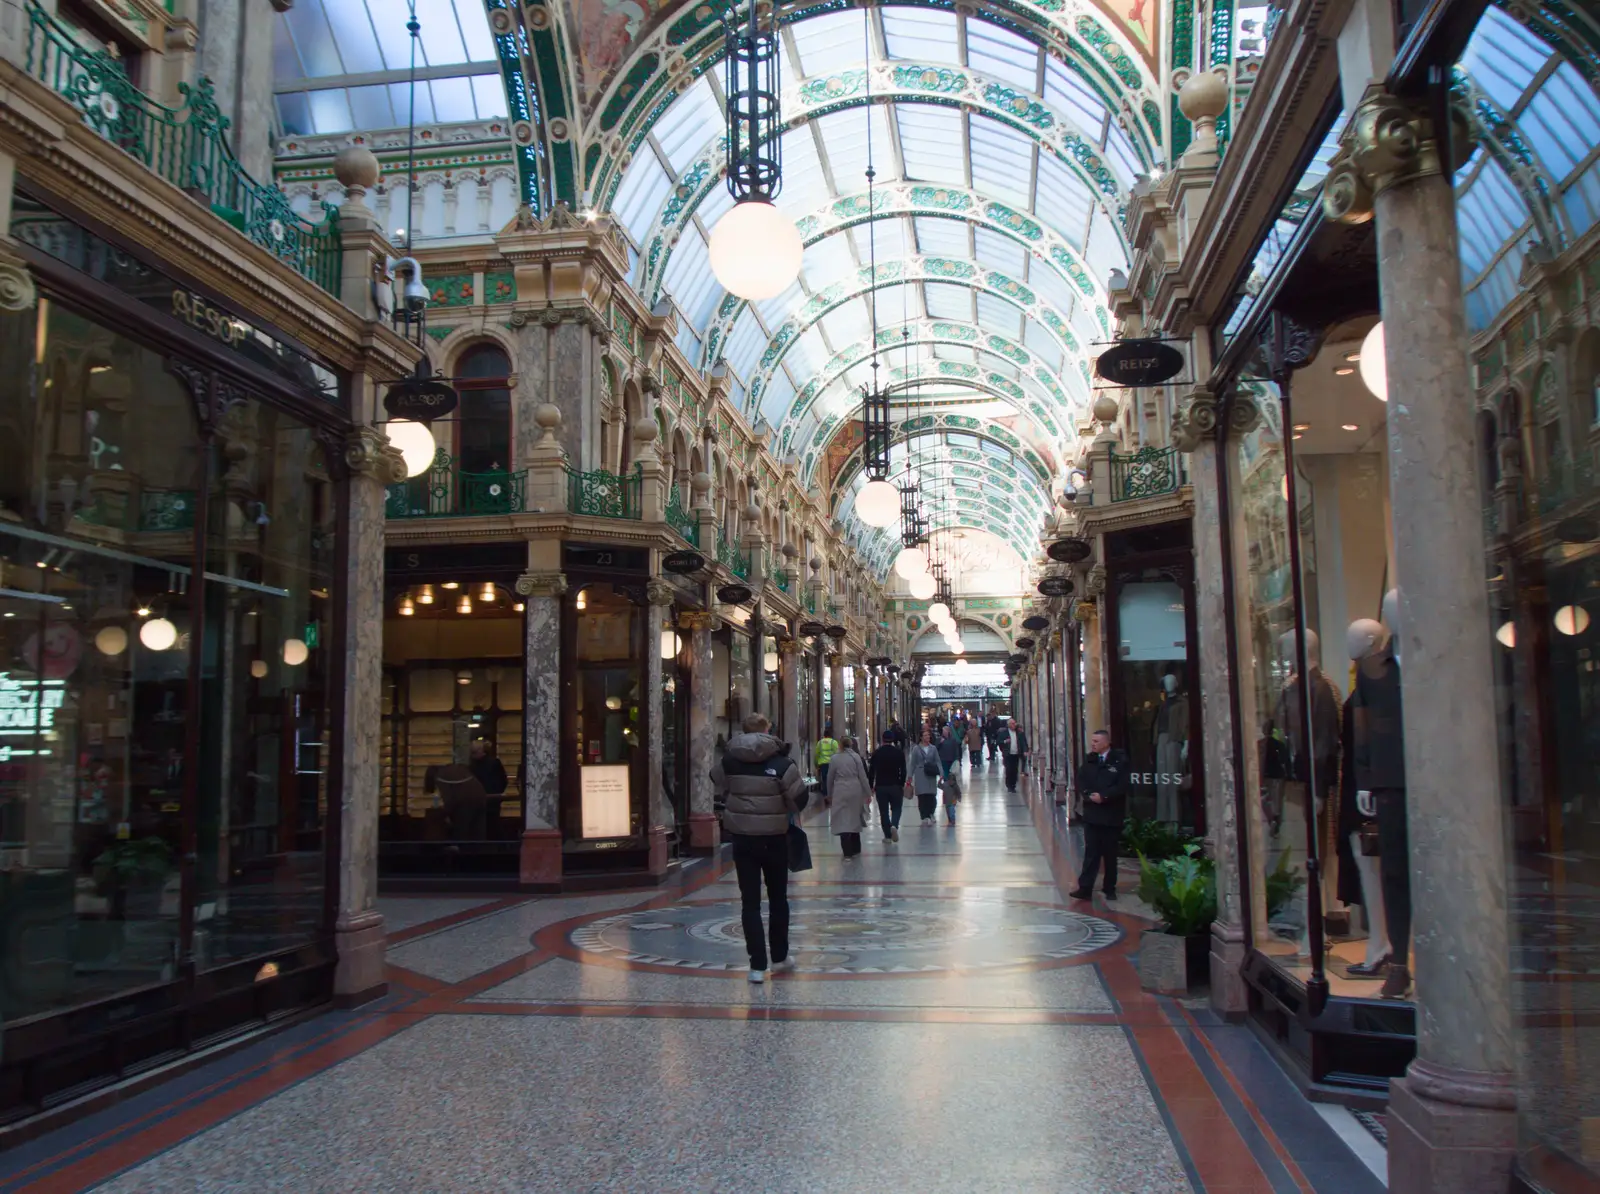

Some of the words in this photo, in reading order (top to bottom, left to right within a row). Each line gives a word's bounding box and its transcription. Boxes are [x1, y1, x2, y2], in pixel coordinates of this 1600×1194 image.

[1119, 357, 1159, 370] REISS
[397, 393, 446, 407] AESOP
[596, 553, 613, 566] 23
[1130, 772, 1183, 785] REISS
